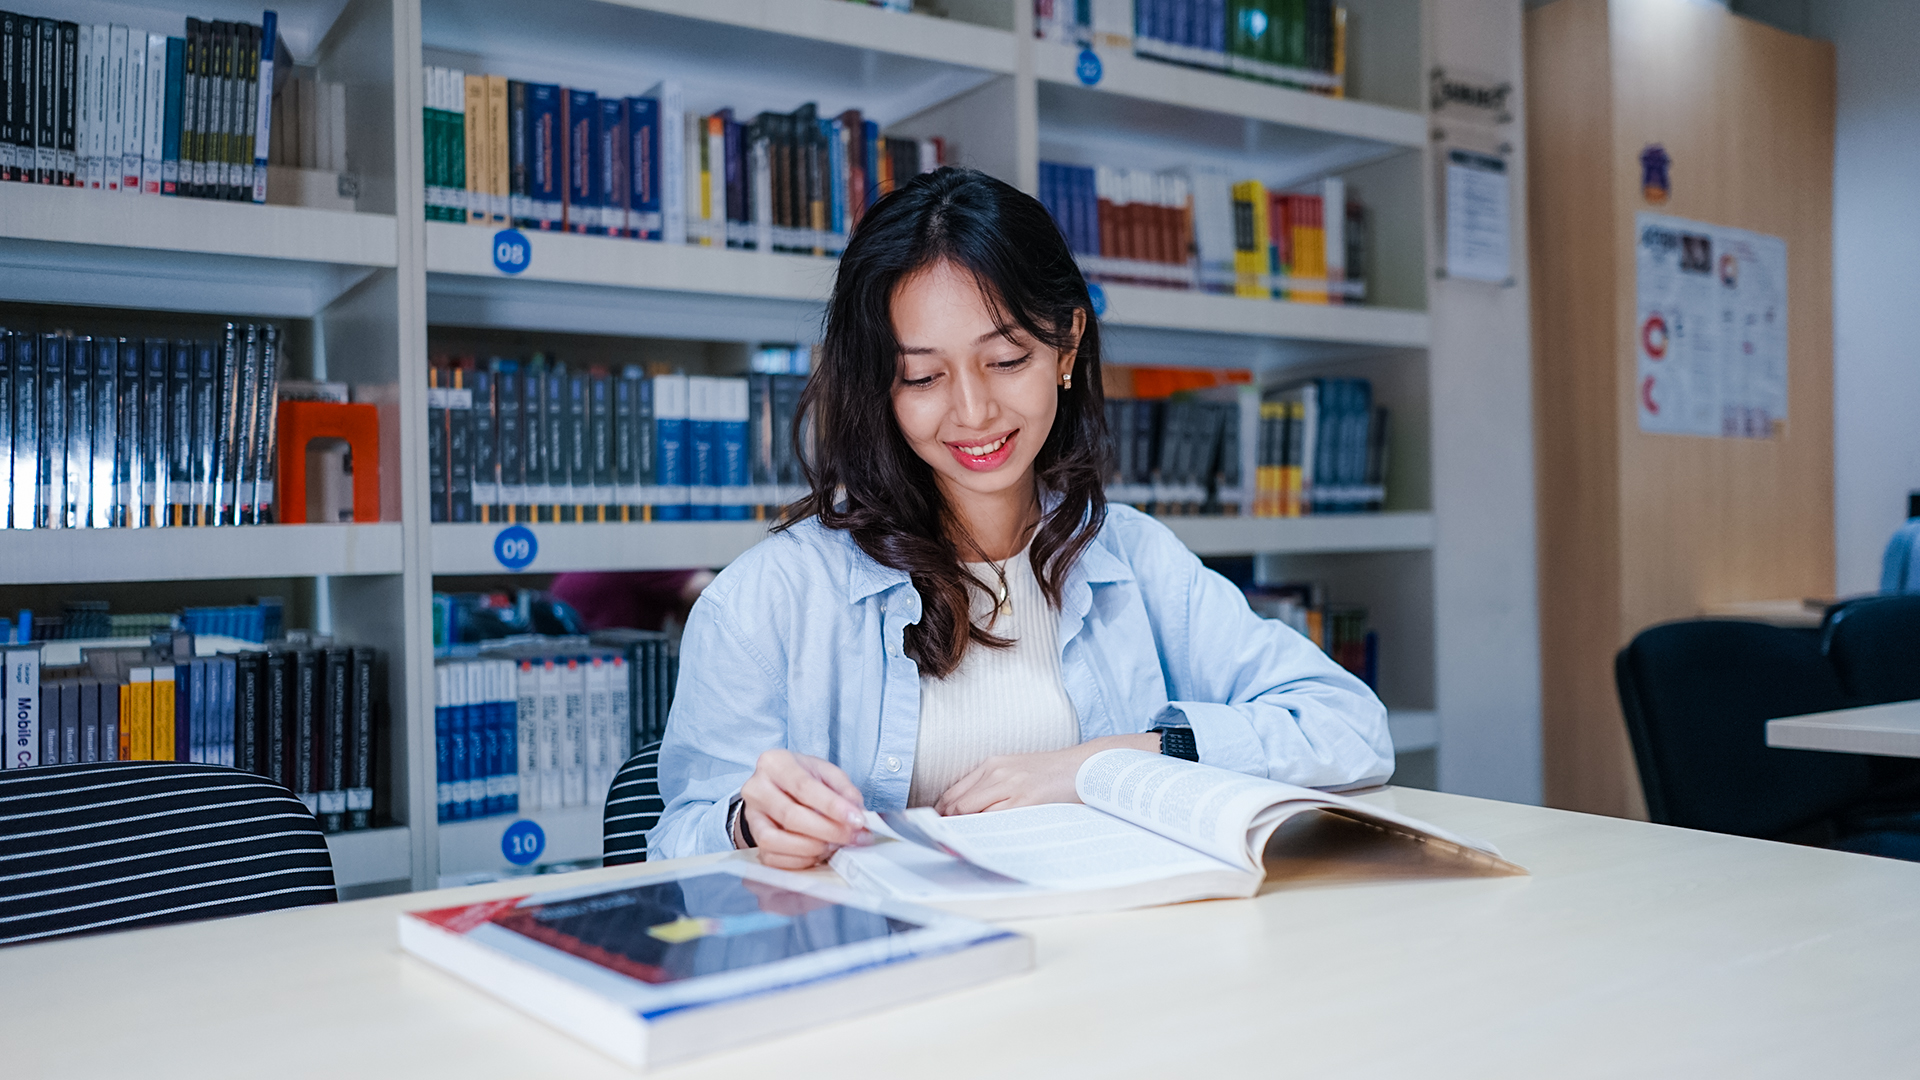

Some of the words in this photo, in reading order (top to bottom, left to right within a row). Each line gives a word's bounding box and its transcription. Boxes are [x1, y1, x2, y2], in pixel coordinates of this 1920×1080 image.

[497, 242, 524, 264] 08
[502, 538, 529, 559] 09
[18, 698, 31, 746] Mobile
[512, 833, 537, 854] 10
